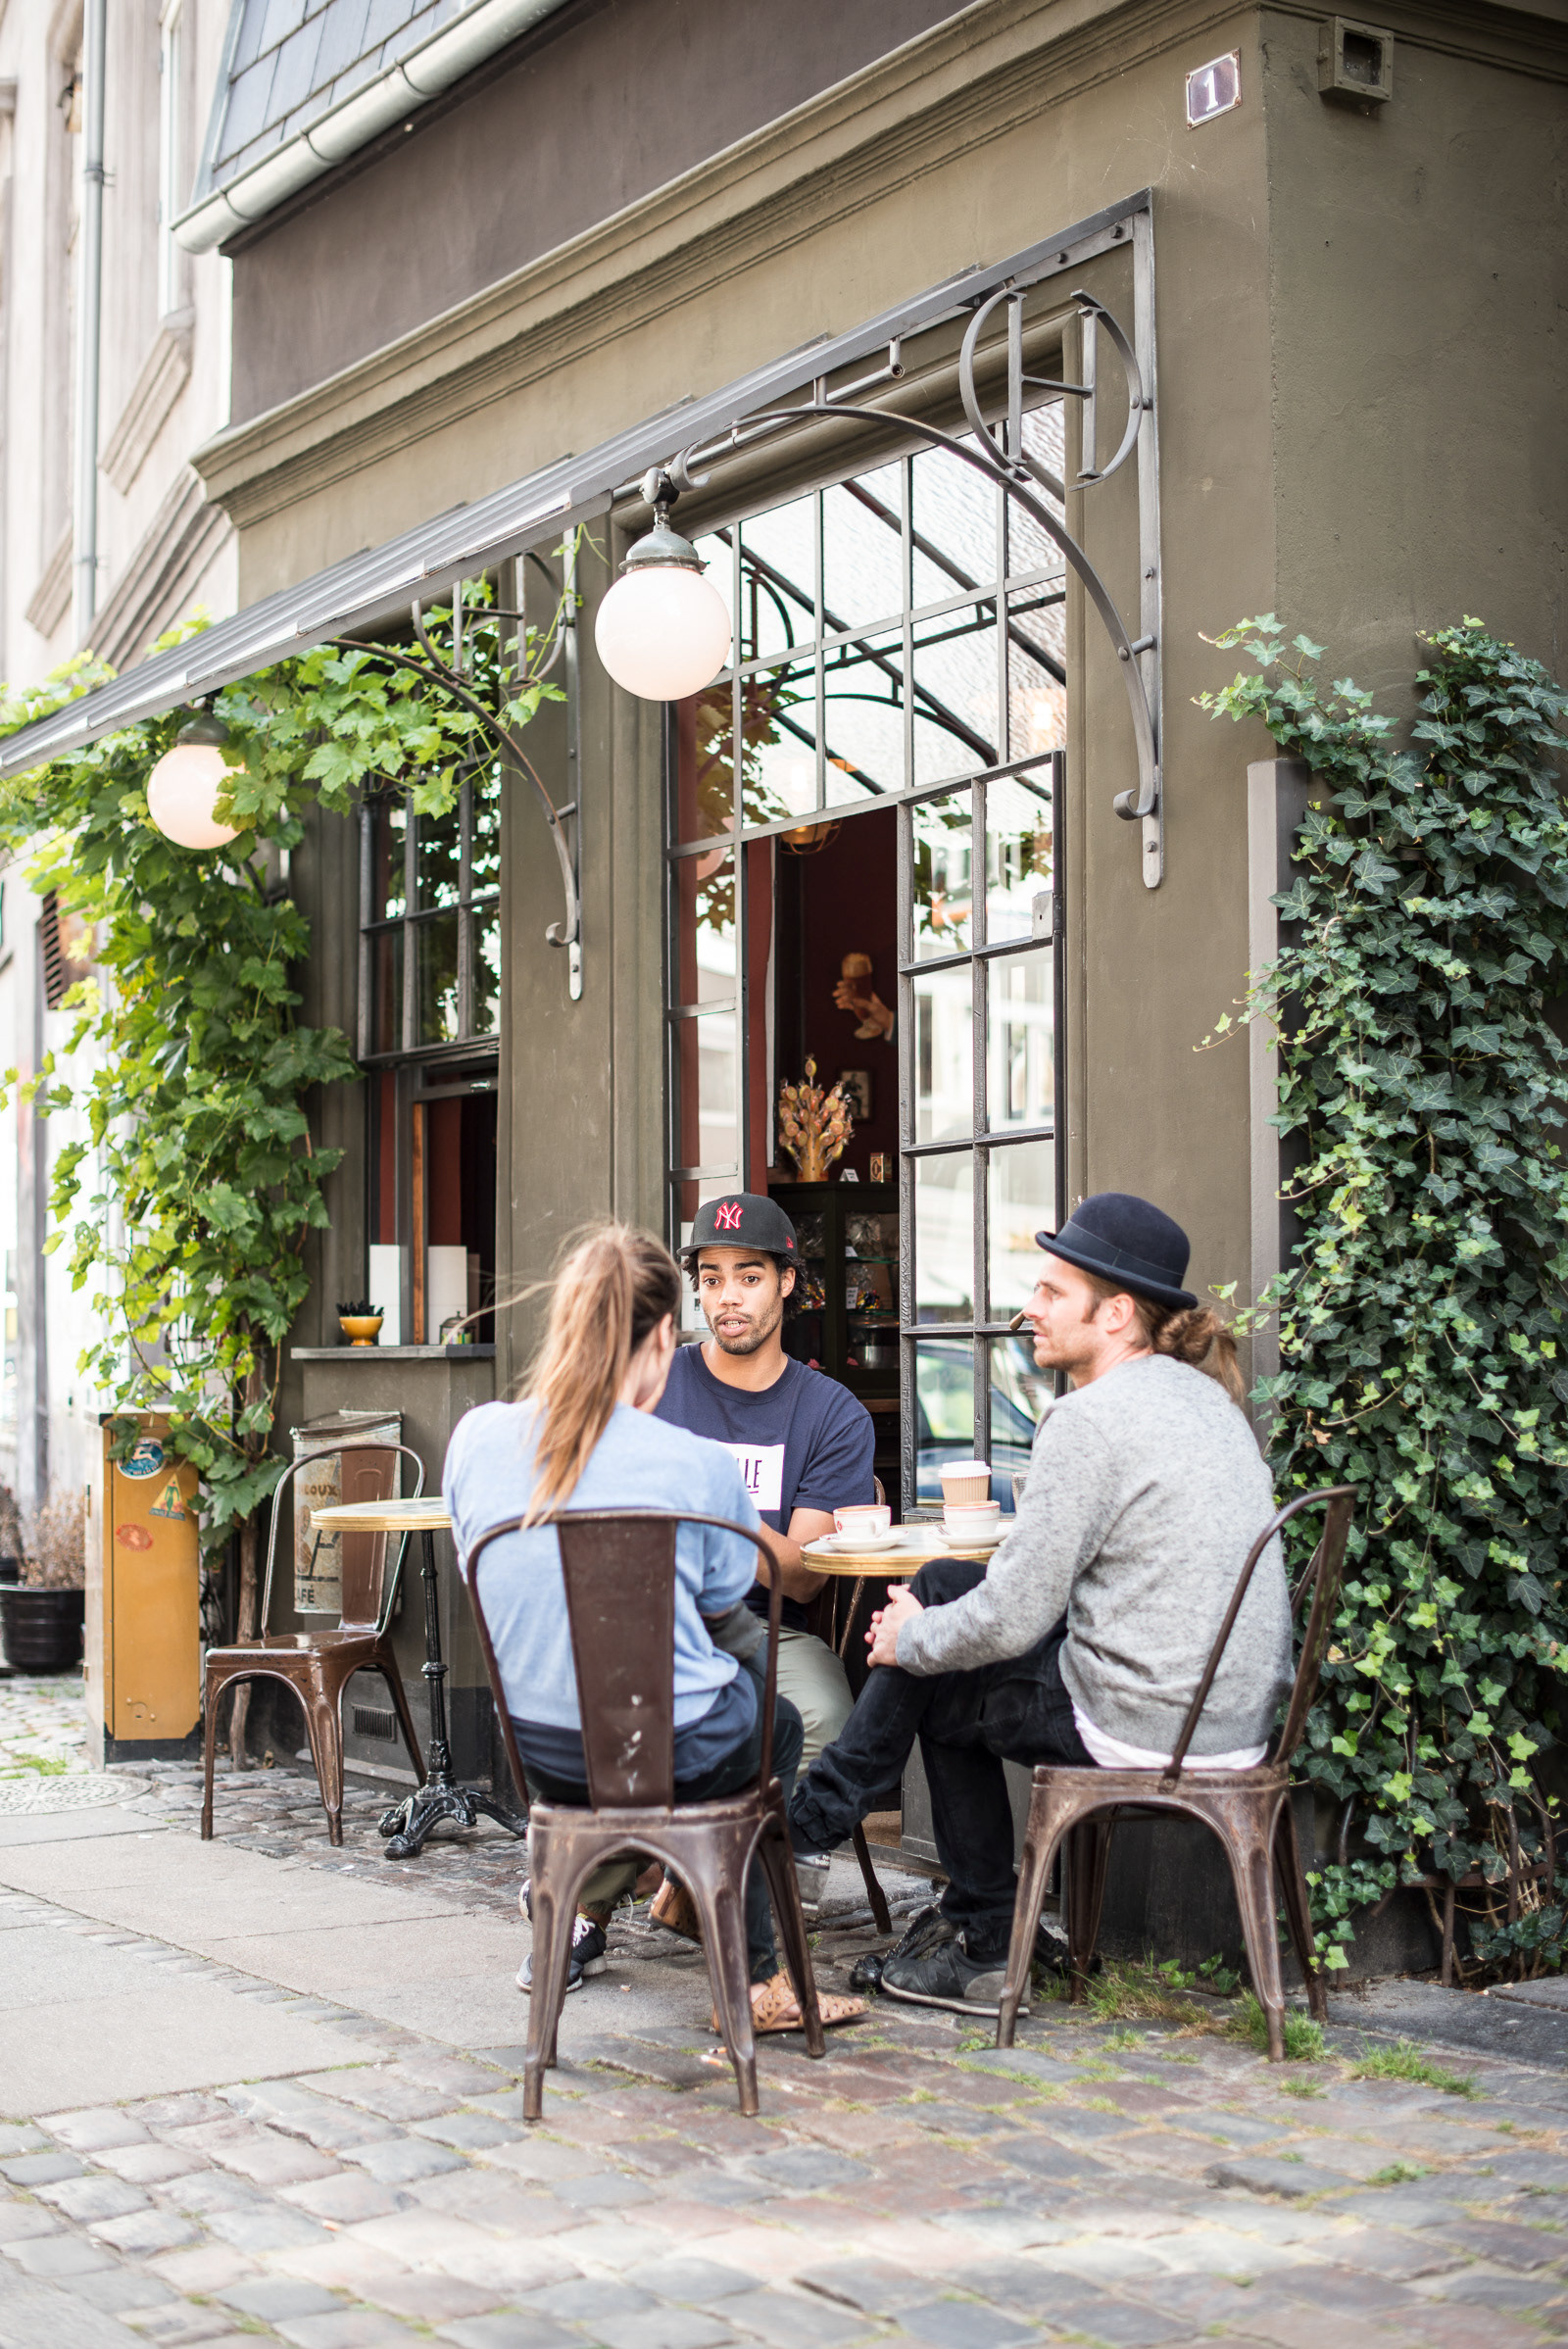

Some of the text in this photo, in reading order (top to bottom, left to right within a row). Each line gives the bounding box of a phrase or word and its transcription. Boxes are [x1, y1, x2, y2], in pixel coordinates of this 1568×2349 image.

[1204, 70, 1218, 112] 1
[714, 1201, 743, 1230] NY
[737, 1458, 762, 1489] LE
